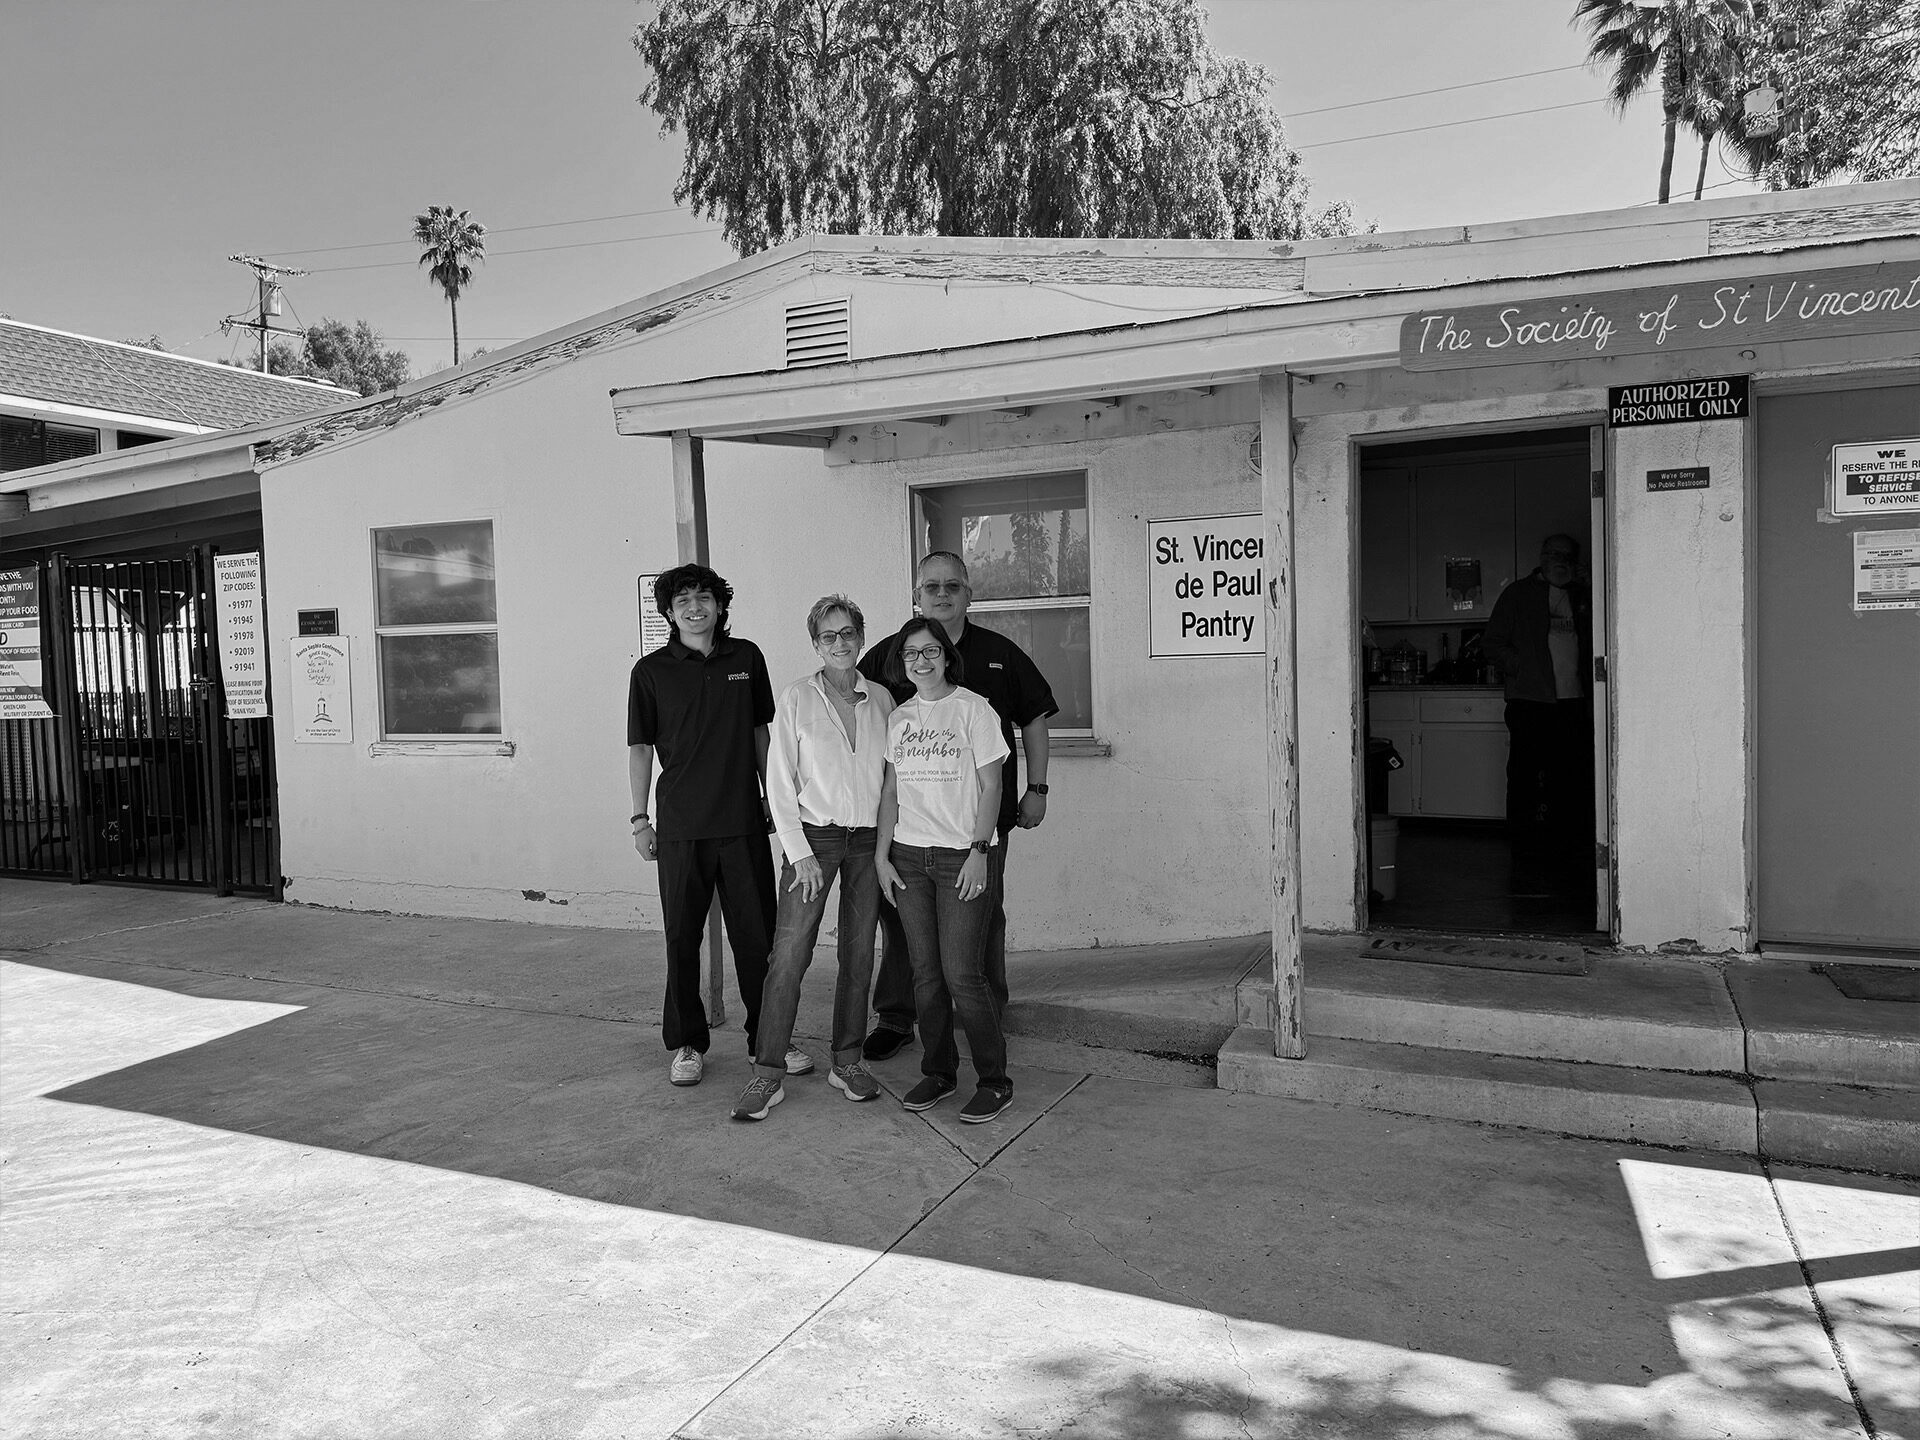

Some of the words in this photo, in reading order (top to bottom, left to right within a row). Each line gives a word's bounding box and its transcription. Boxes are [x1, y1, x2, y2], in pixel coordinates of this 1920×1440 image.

[1420, 316, 1472, 353] The
[1486, 307, 1617, 351] Society
[1639, 294, 1678, 345] of
[1698, 287, 1751, 329] St
[1765, 276, 1920, 323] Vincent
[1620, 380, 1730, 405] AUTHORIZED
[1612, 402, 1695, 423] PERSONNEL
[1699, 398, 1743, 416] ONLY
[1877, 449, 1906, 458] WE
[1842, 462, 1885, 472] RESERVE
[1889, 460, 1908, 469] THE
[1660, 472, 1678, 480] We're
[1679, 471, 1696, 479] Sorry
[1858, 475, 1874, 484] TO
[1878, 472, 1920, 483] REFUSE
[1868, 482, 1913, 493] SERVICE
[1863, 496, 1876, 505] TO
[1880, 494, 1919, 504] ANYONE
[1155, 537, 1184, 565] St.
[216, 560, 226, 569] WE
[227, 558, 246, 568] SERVE
[246, 557, 258, 566] THE
[221, 569, 257, 580] FOLLOWING
[7, 583, 21, 591] WITH
[22, 582, 34, 590] YOU
[223, 584, 233, 592] ZIP
[234, 582, 256, 591] CODES:
[1175, 572, 1204, 599] de
[1213, 568, 1262, 597] Paul
[232, 600, 253, 609] 91977
[6, 607, 21, 616] YOUR
[21, 605, 39, 615] FOOD
[233, 615, 253, 625] 91945
[1182, 610, 1255, 642] Pantry
[234, 631, 254, 640] 91978
[234, 646, 255, 656] 92019
[296, 647, 308, 658] Santa
[322, 642, 344, 657] Conference
[234, 662, 255, 671] 91941
[942, 728, 956, 741] thy
[907, 741, 961, 762] neighbor
